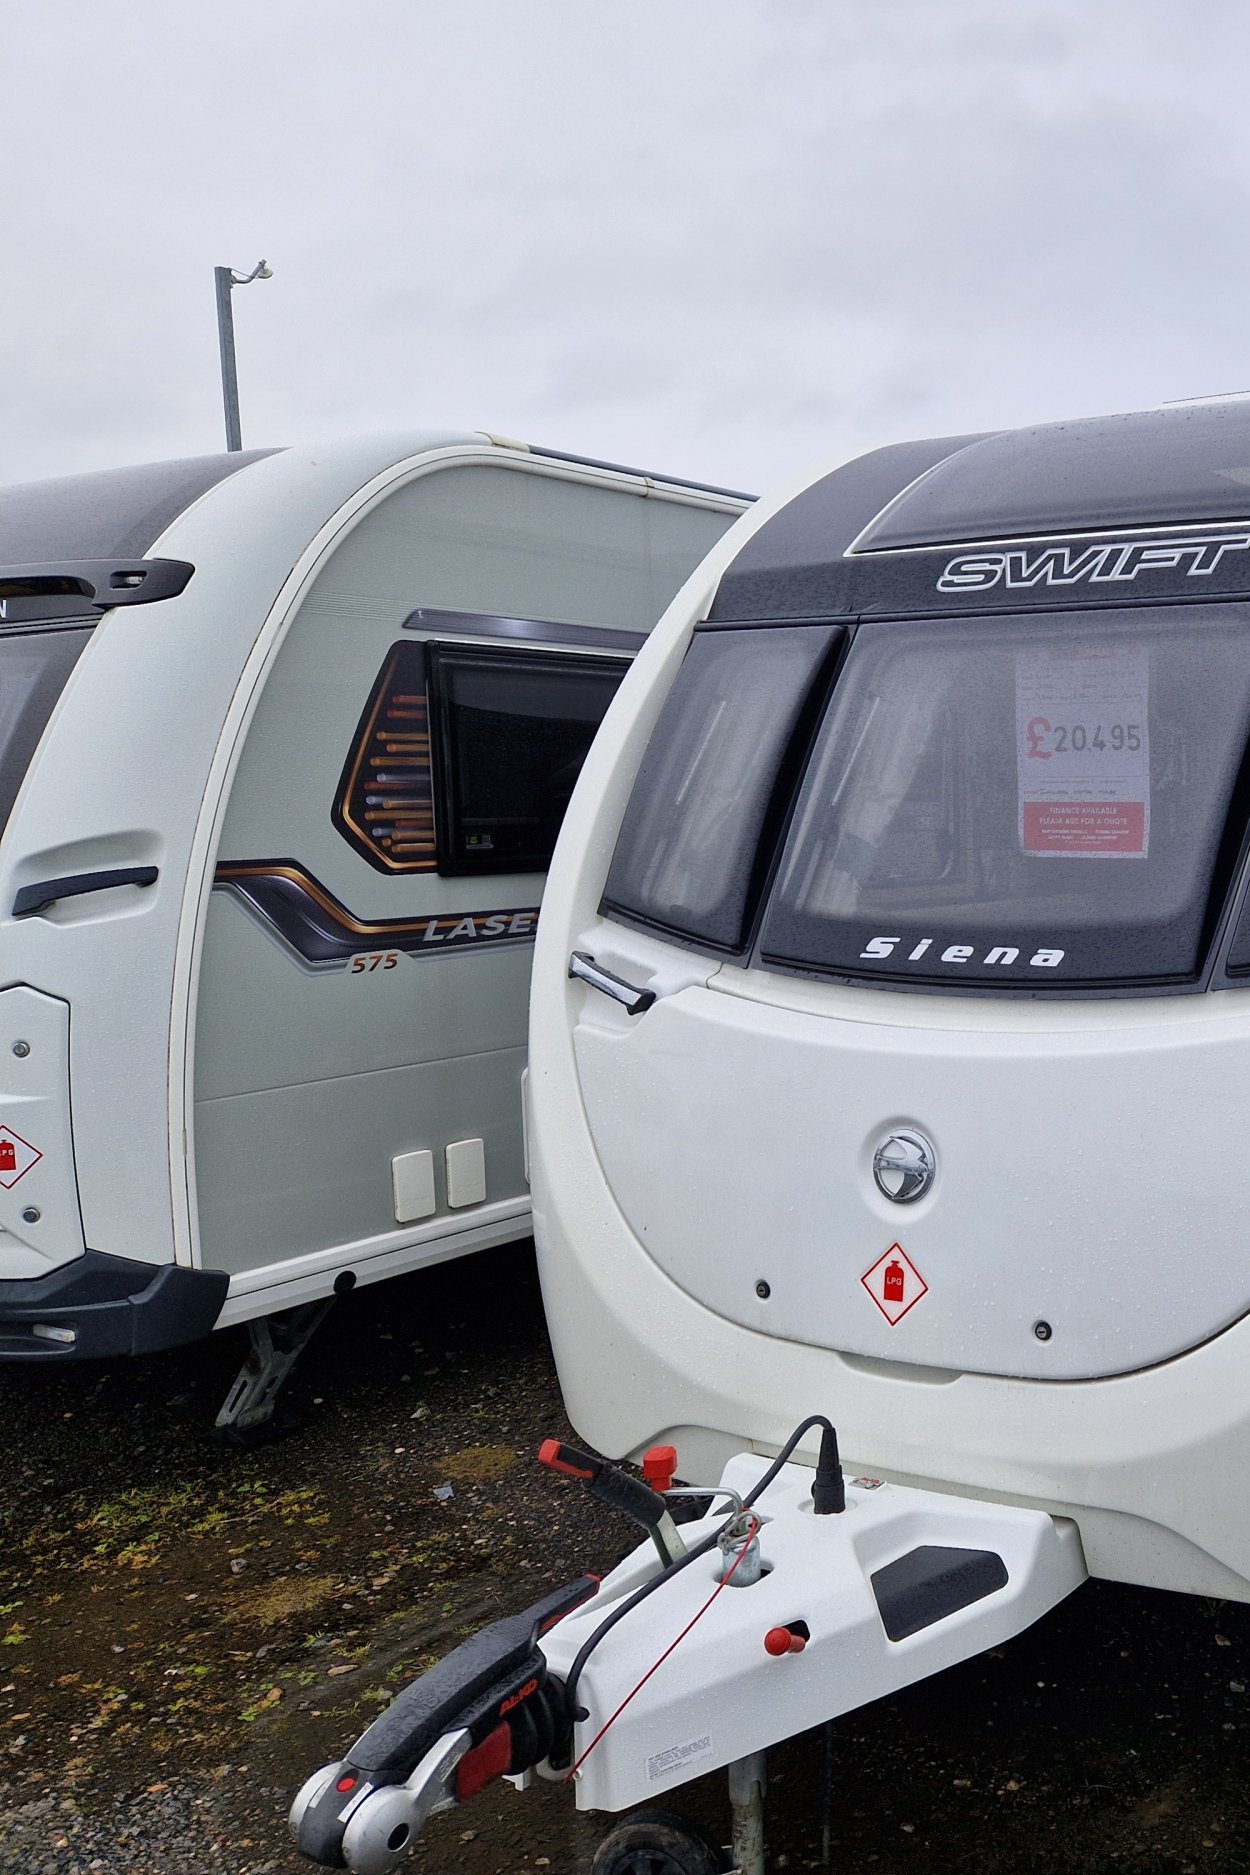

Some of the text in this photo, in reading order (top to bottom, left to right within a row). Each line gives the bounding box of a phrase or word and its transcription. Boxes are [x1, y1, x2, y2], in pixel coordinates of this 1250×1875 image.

[1026, 716, 1141, 759] £20,495
[351, 953, 398, 974] 575
[859, 936, 1065, 967] Siena
[886, 1276, 902, 1286] LPG
